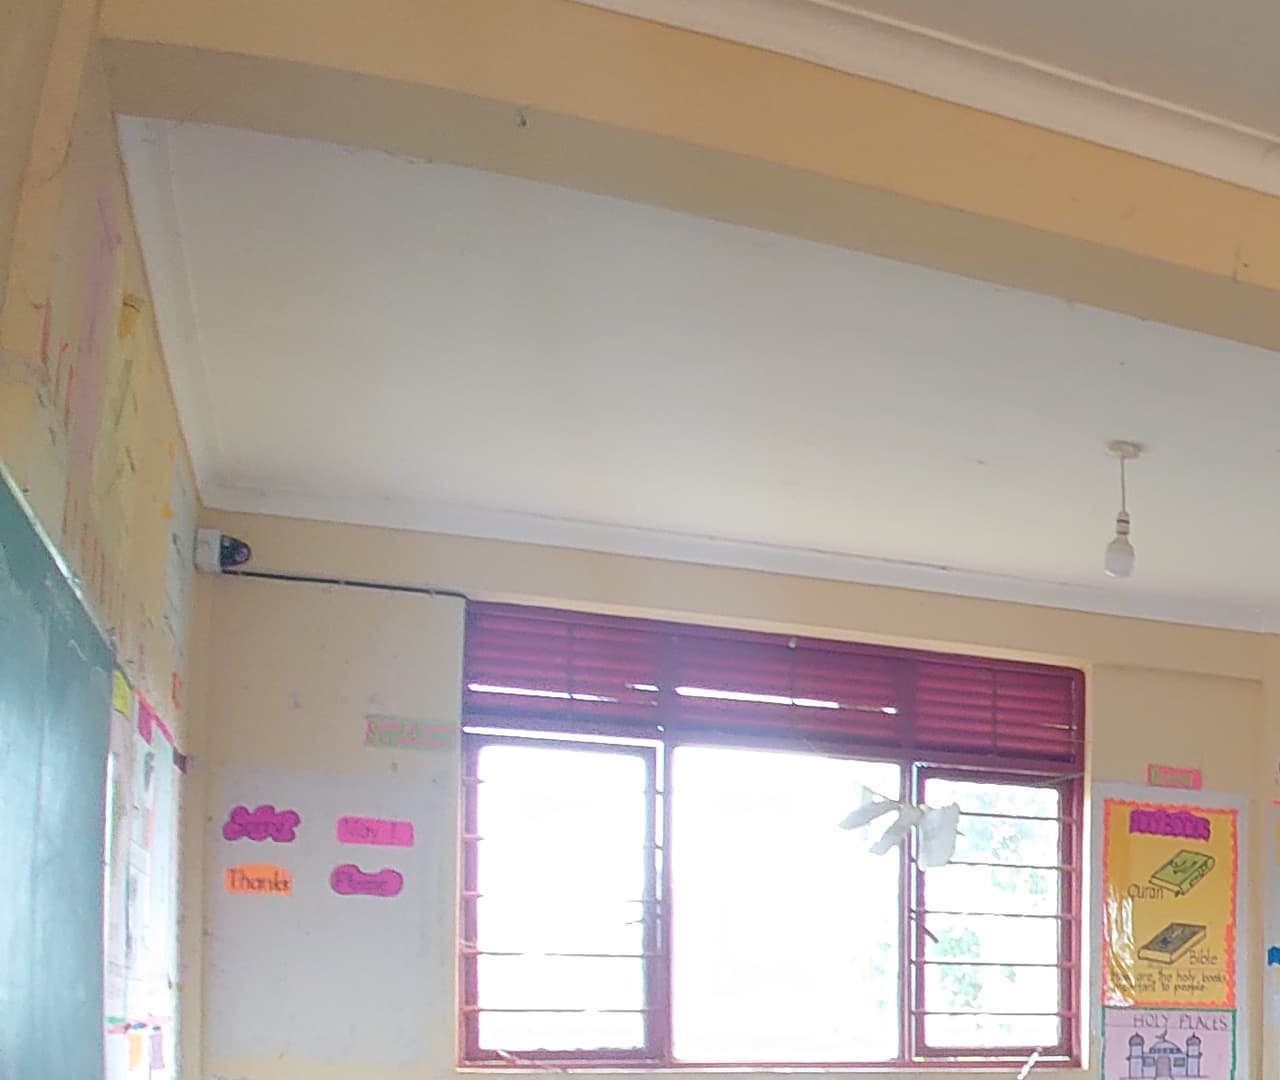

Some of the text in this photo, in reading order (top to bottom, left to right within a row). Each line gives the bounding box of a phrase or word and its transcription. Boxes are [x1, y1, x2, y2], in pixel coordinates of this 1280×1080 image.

[1189, 951, 1219, 966] Bible
[1134, 1013, 1228, 1031] HOLY PLACES
